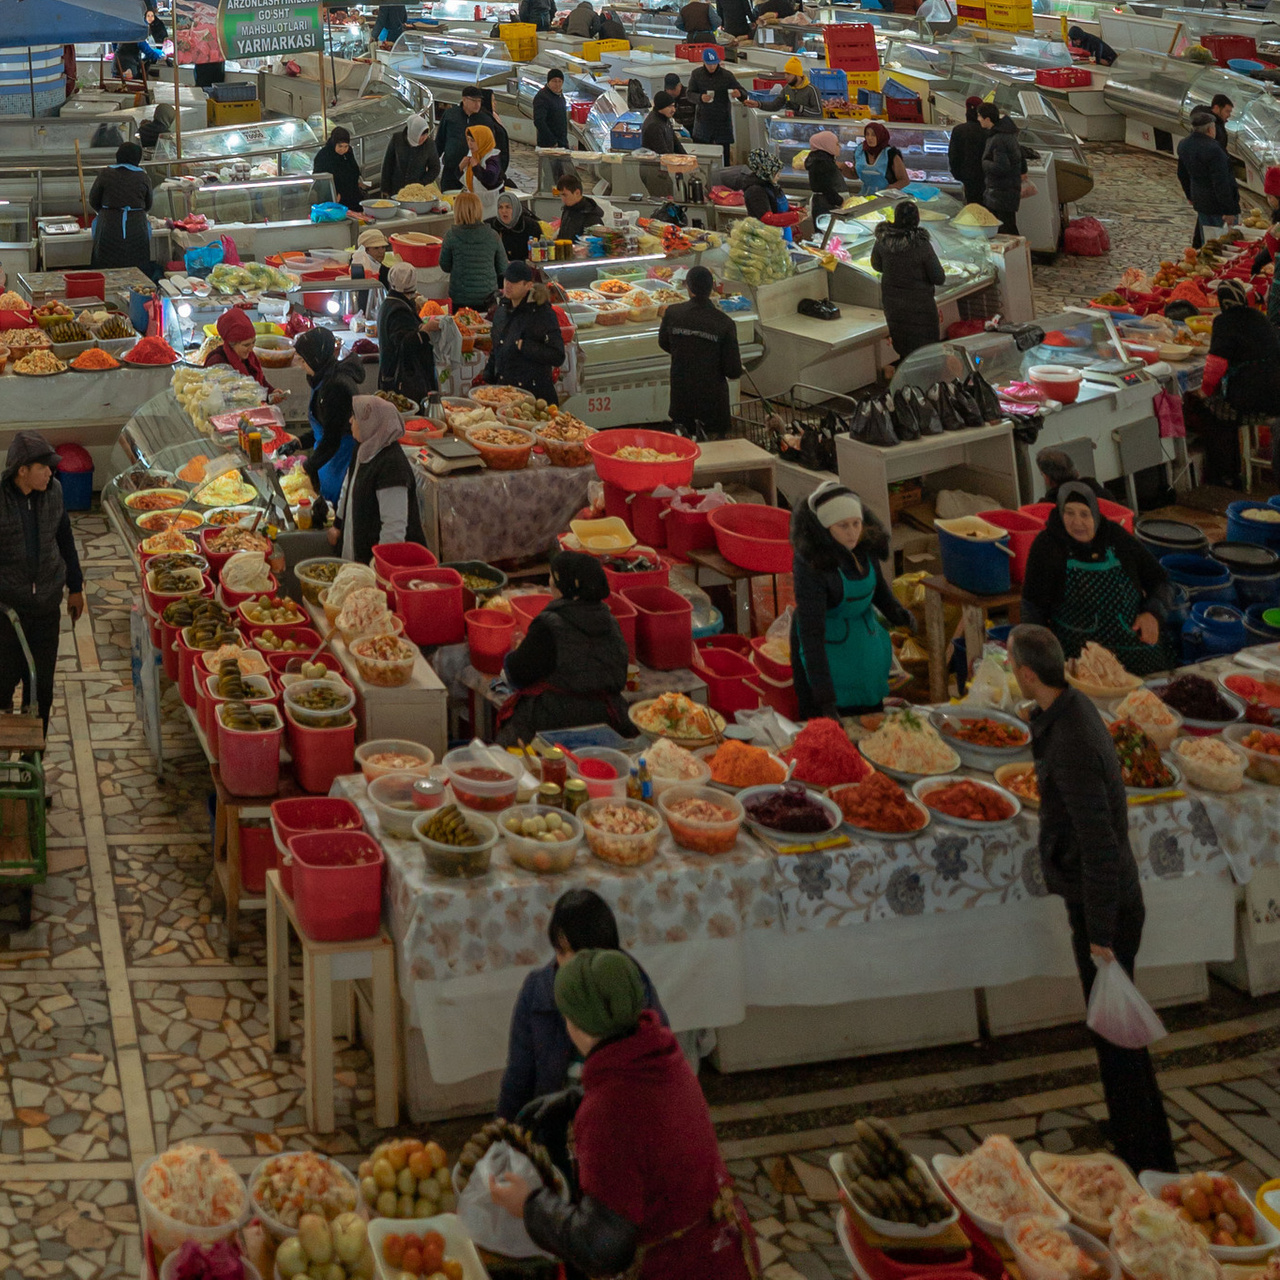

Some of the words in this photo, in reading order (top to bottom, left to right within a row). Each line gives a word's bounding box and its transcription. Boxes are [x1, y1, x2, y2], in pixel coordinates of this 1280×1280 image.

[241, 20, 308, 36] MAHSULOTLARI
[237, 33, 316, 54] YARMARKASI
[588, 396, 611, 413] 532
